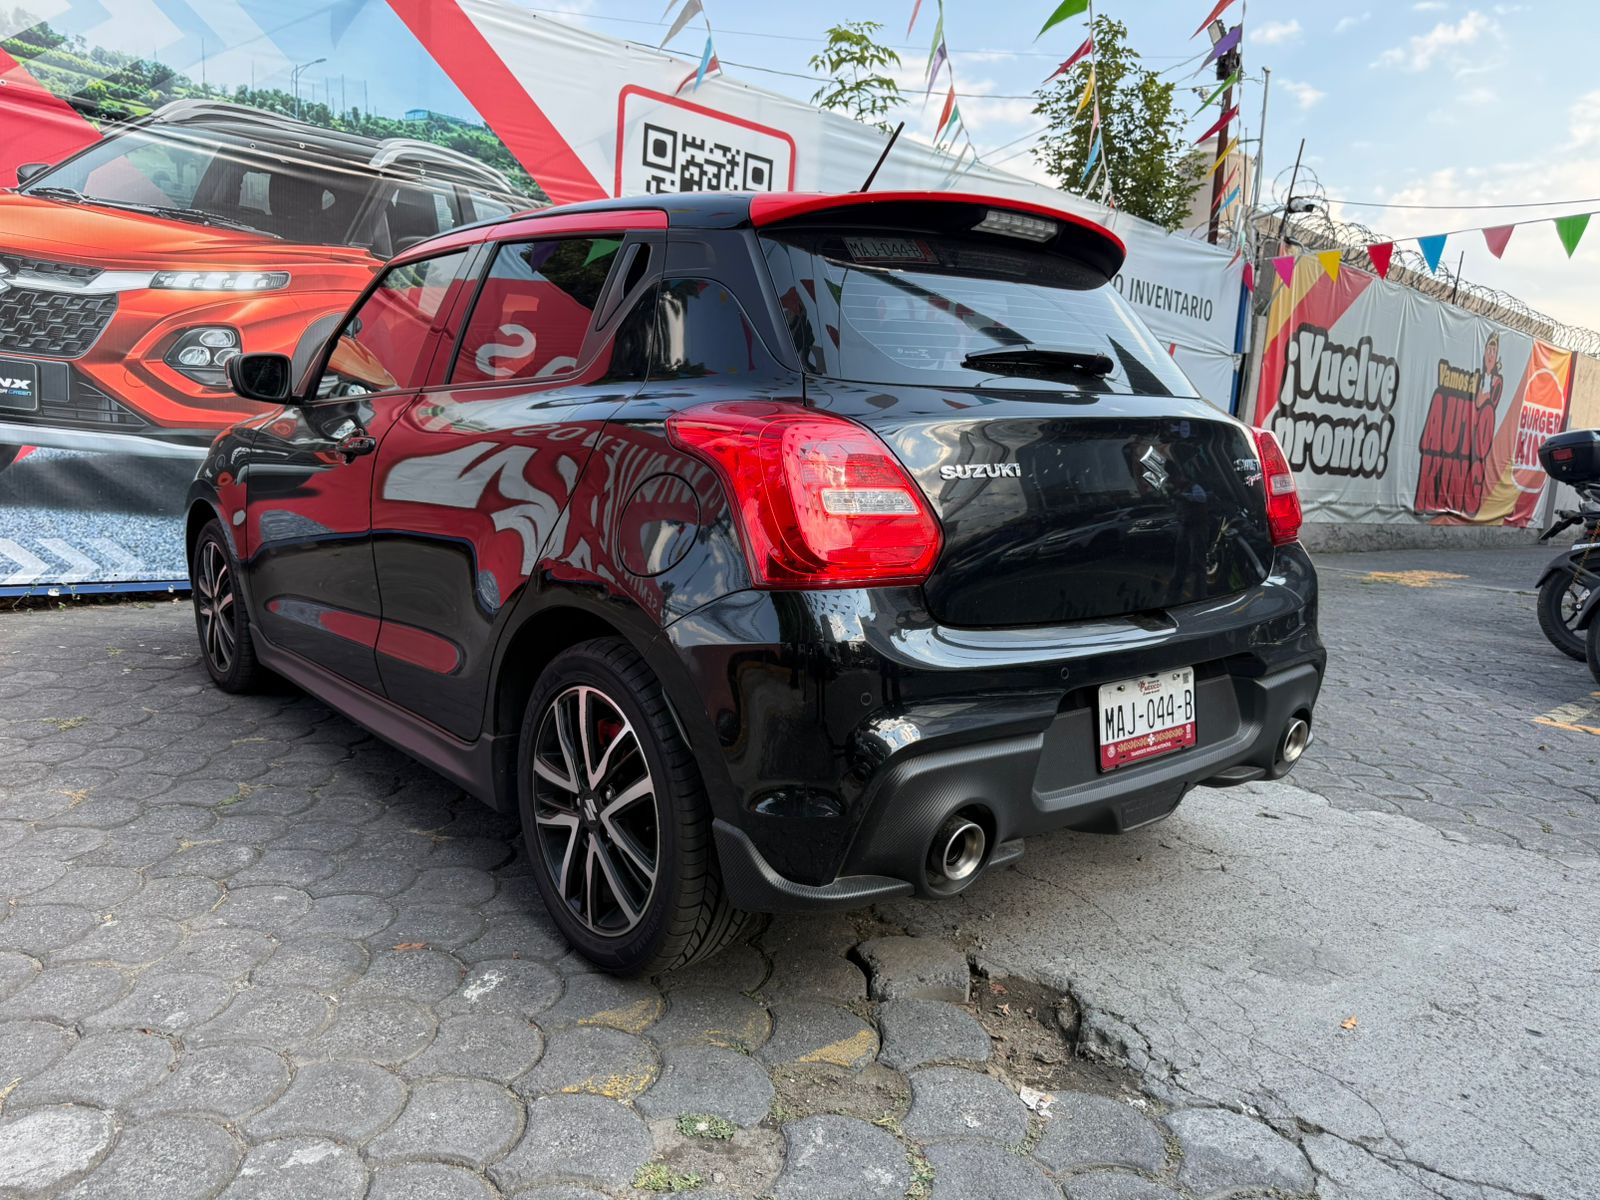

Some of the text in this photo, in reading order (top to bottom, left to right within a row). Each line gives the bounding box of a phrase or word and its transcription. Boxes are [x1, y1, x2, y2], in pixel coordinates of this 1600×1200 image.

[1129, 278, 1213, 322] INVENTARIO
[1280, 329, 1397, 409] ¡Vuelve
[1421, 393, 1495, 458] AUTO
[1520, 405, 1561, 435] BURGER
[940, 463, 1021, 480] SUZUKI
[1515, 430, 1546, 467] KIN
[1415, 454, 1484, 515] KING
[1104, 689, 1193, 741] MAJ-044-B
